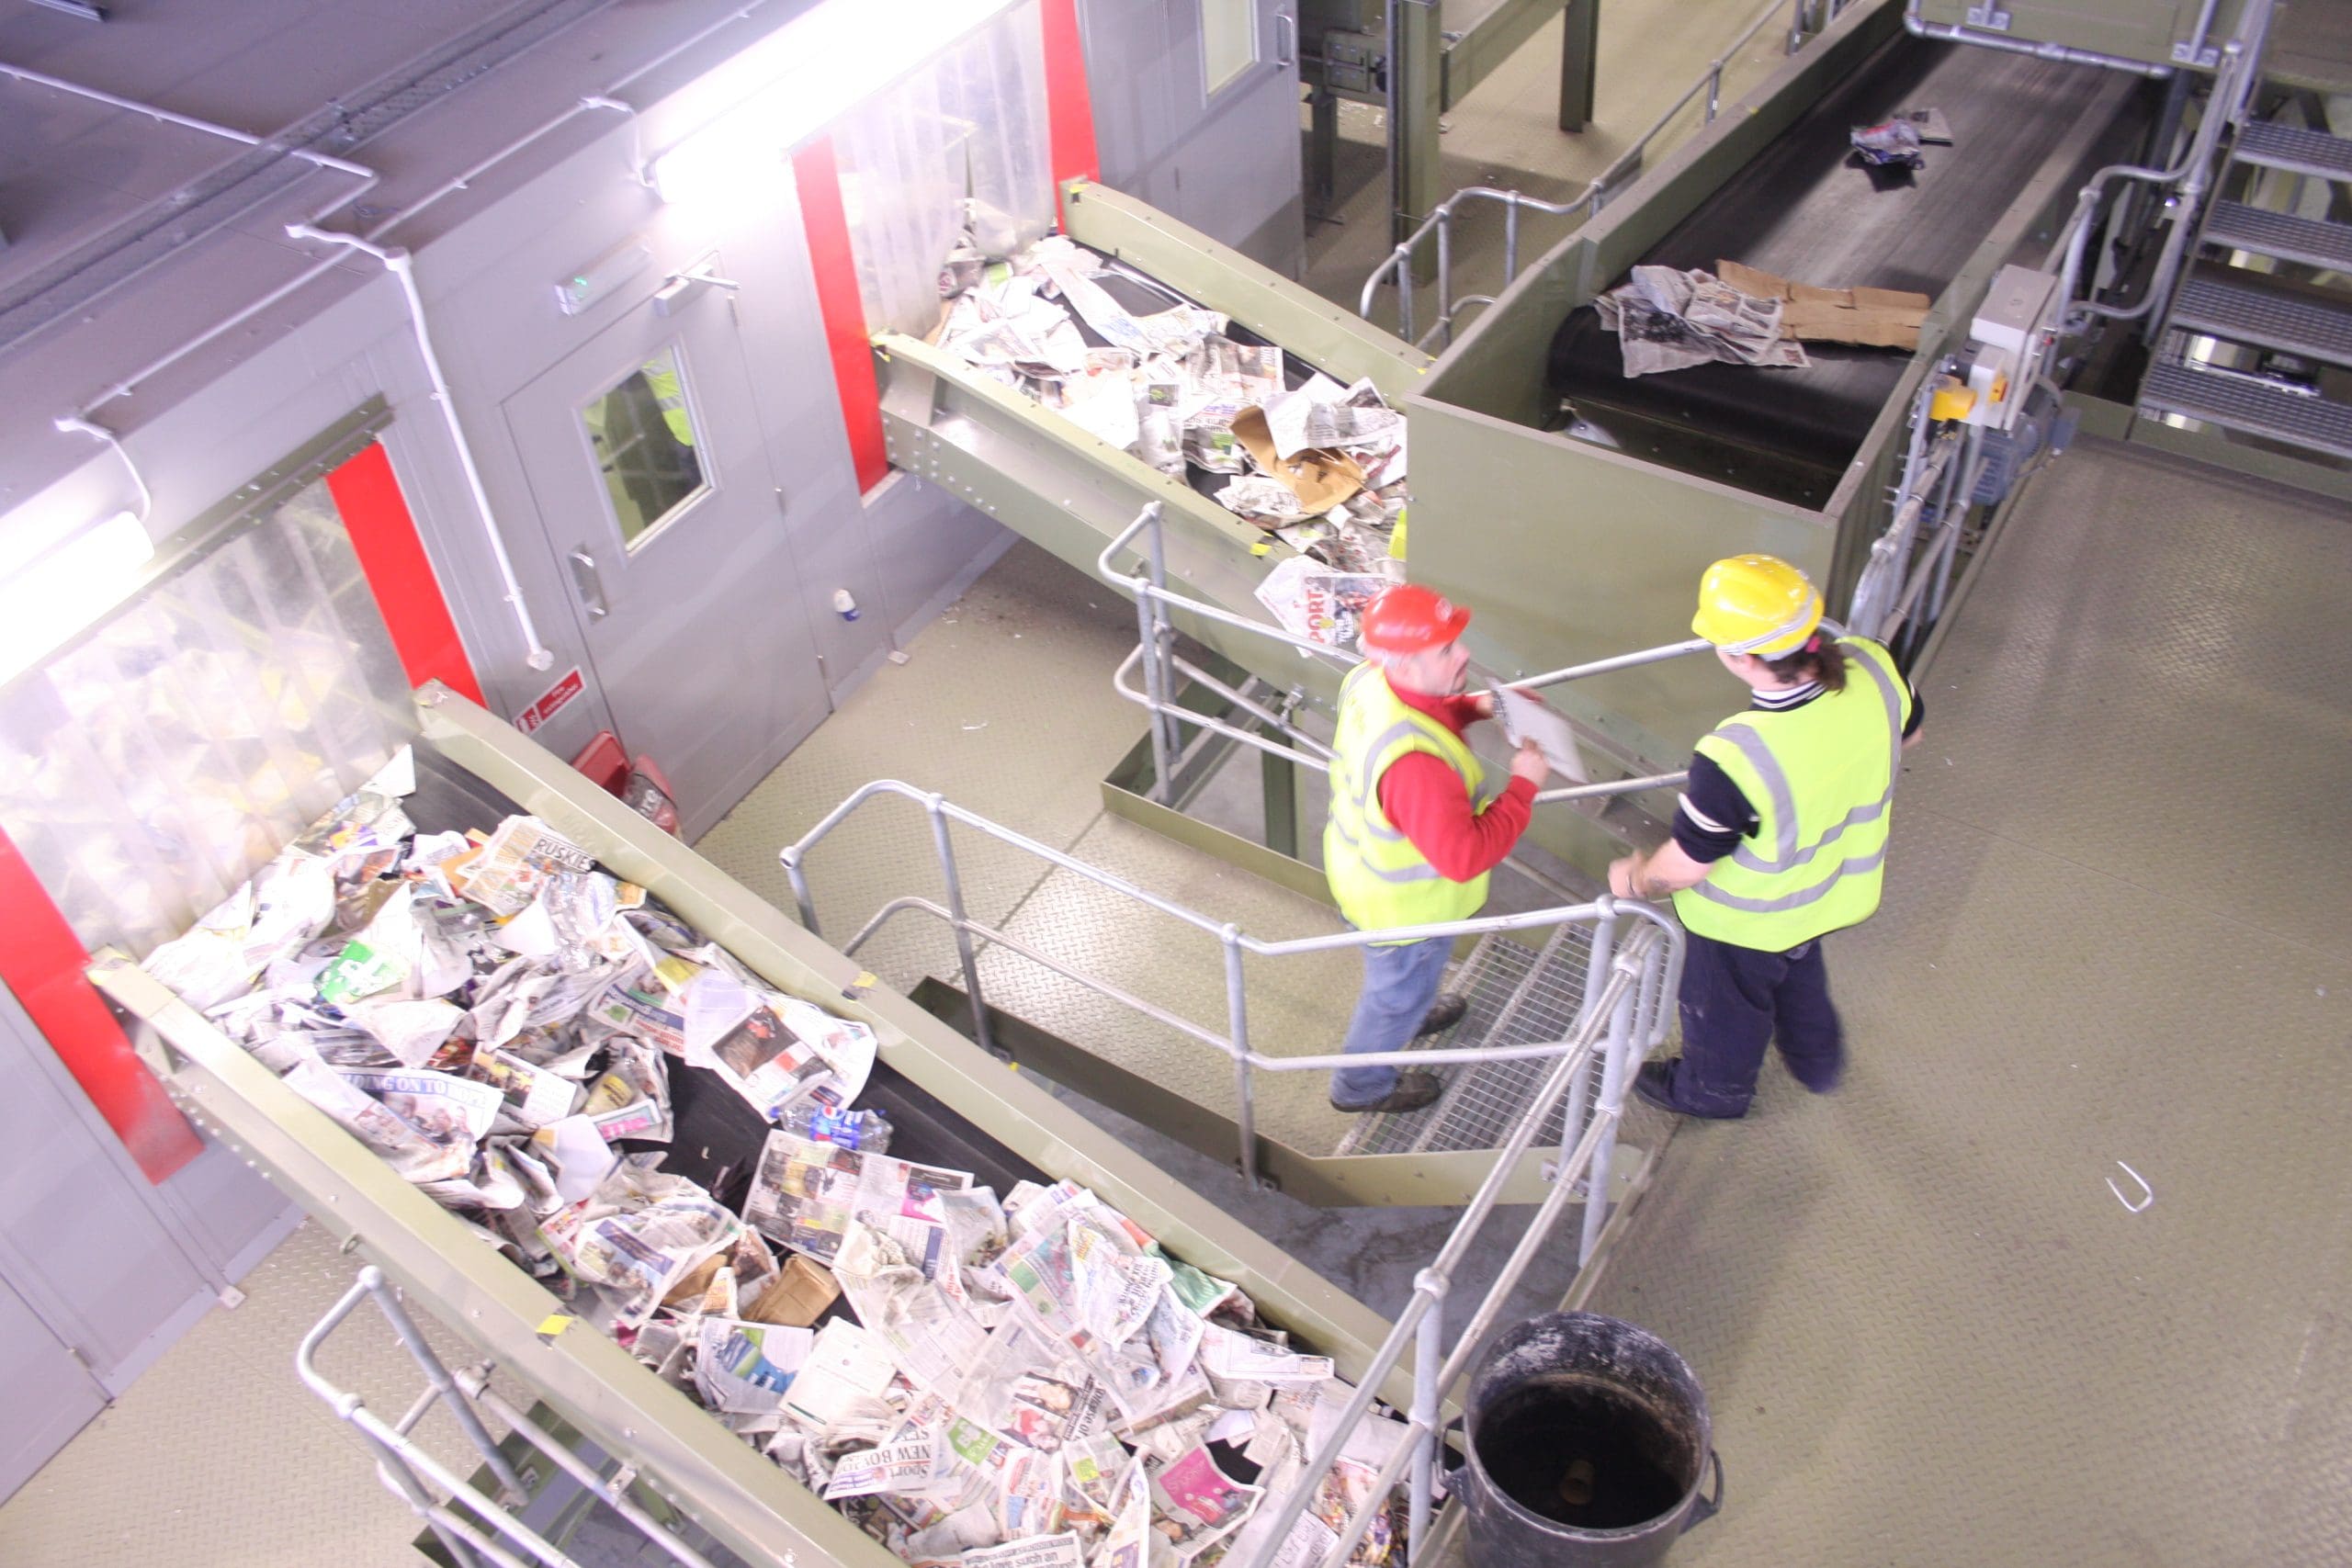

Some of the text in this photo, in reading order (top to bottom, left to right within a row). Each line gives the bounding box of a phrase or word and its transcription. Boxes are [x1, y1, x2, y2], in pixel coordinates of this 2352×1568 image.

[1306, 588, 1325, 644] PORT
[533, 837, 596, 871] RUSKIES
[396, 1077, 423, 1091] ON
[425, 1078, 447, 1094] TO
[898, 1444, 933, 1461] NEW
[890, 1464, 930, 1479] Sport
